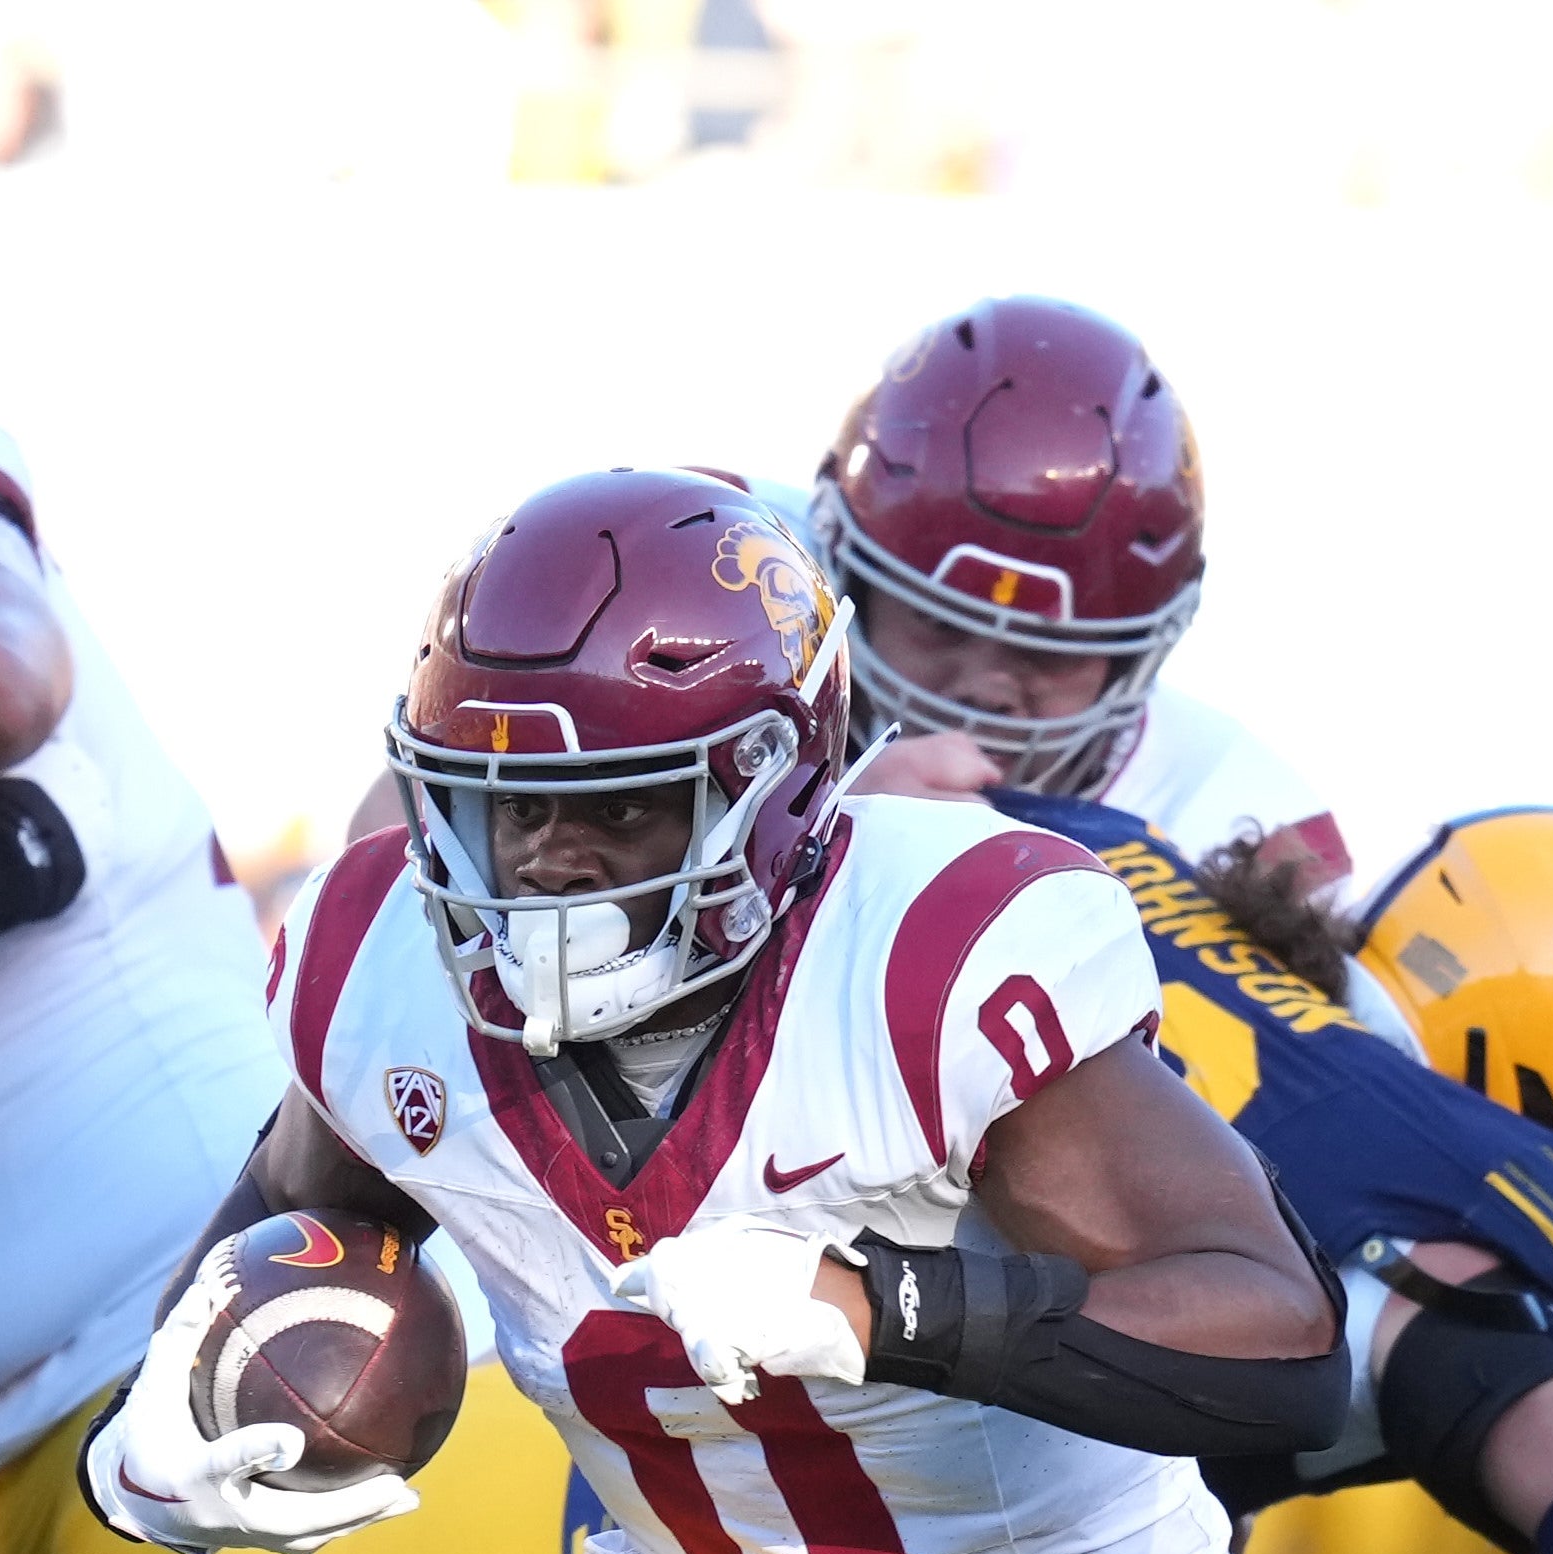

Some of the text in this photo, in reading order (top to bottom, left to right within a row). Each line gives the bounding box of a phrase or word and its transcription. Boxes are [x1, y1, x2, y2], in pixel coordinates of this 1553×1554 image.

[978, 975, 1075, 1100] 0
[388, 1070, 441, 1126] PAC
[404, 1105, 434, 1139] 12
